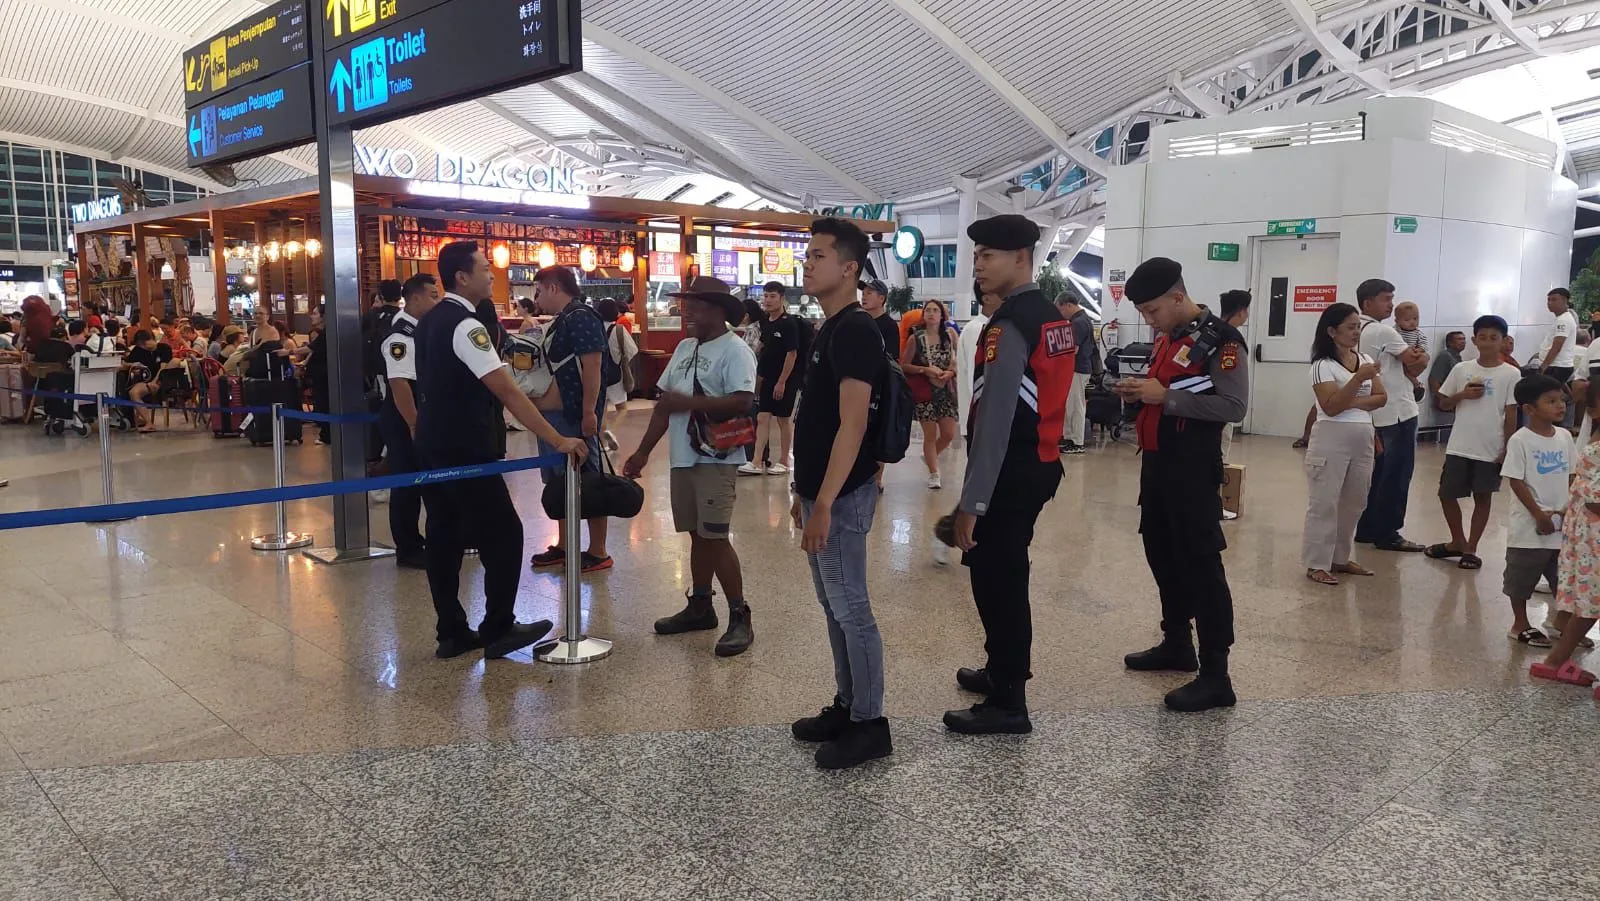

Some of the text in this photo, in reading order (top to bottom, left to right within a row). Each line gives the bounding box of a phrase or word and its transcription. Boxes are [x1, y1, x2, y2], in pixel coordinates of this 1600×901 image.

[380, 0, 397, 20] Exit
[227, 34, 240, 48] Area
[239, 16, 277, 43] Penjemputan
[522, 21, 541, 36] トイレ
[386, 28, 426, 65] Toilet
[241, 57, 259, 74] Pick-Up
[388, 77, 413, 95] Toilets
[218, 88, 284, 121] Pelayanan Pelanggan
[220, 124, 263, 146] Customer Service
[353, 143, 590, 195] WO DRAGONS
[71, 194, 121, 224] TWO DRAGONS
[1540, 450, 1563, 464] NIKE
